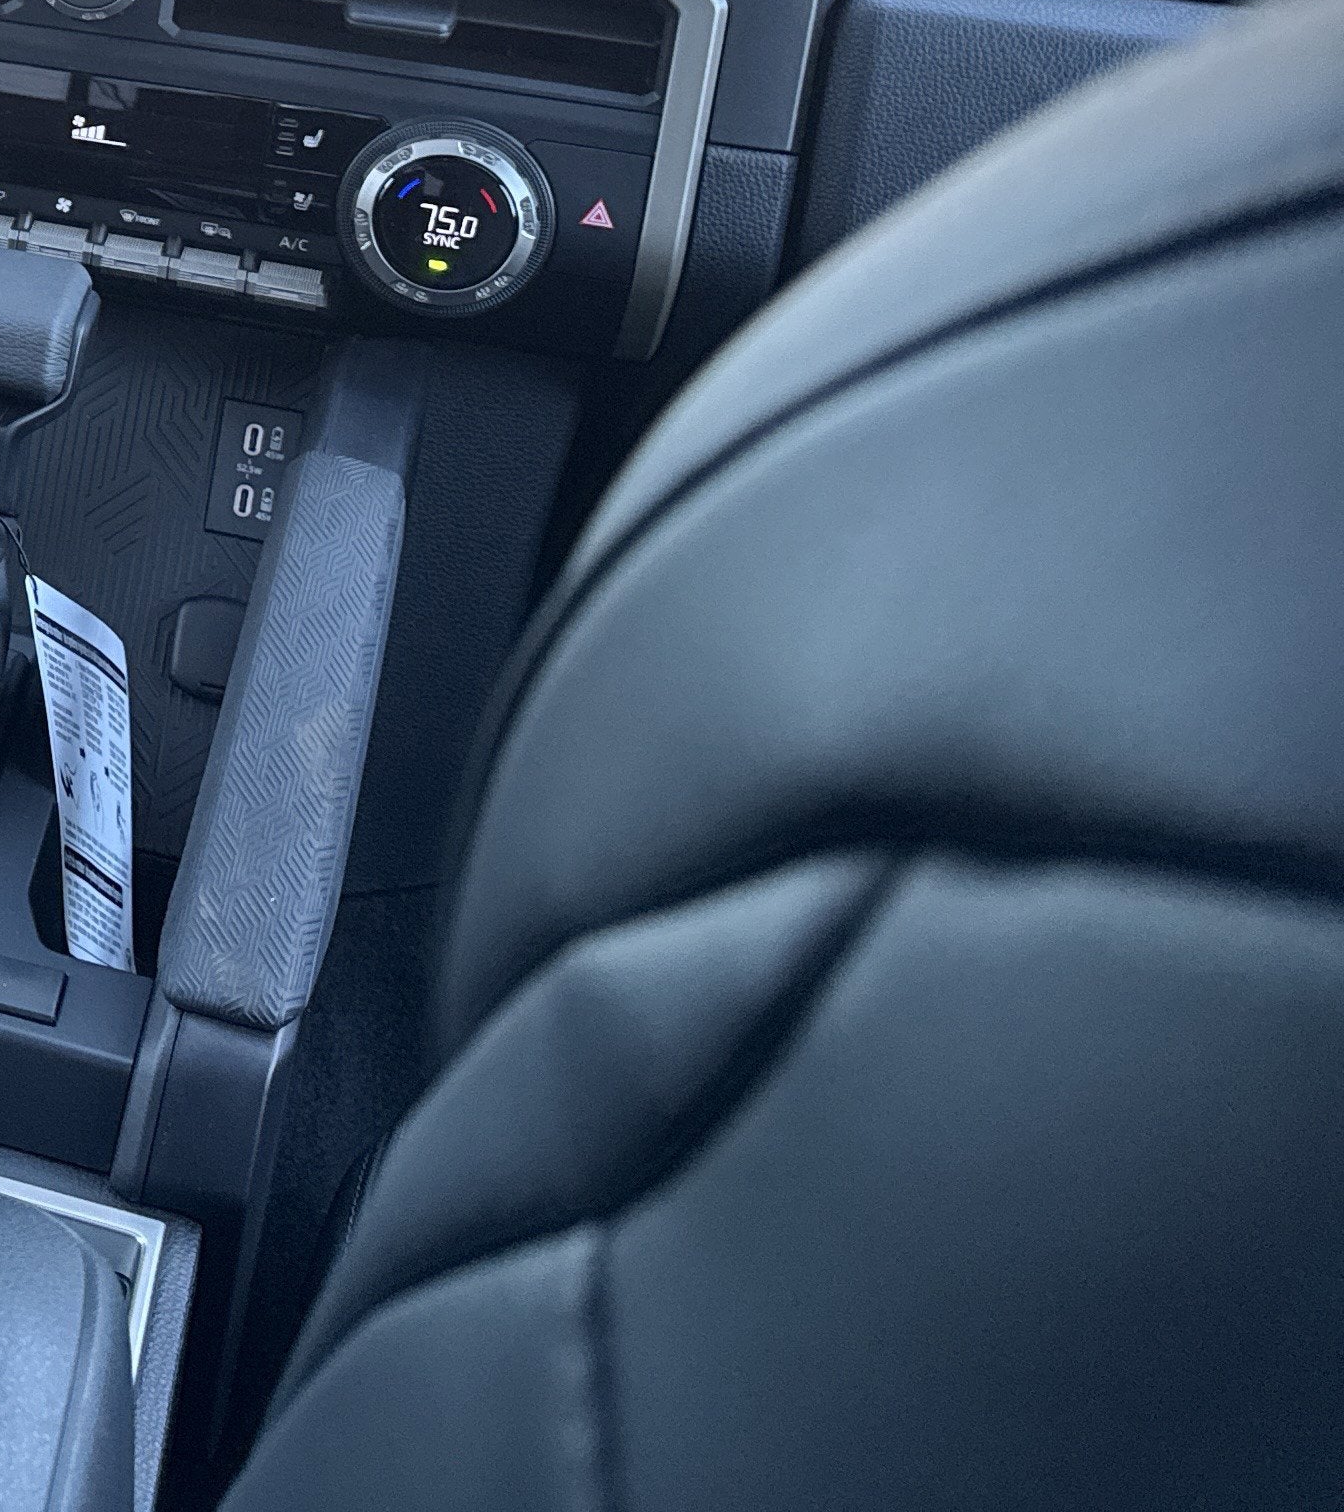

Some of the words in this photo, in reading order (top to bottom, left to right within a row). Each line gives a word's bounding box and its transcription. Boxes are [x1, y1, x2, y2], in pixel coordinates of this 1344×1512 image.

[419, 202, 479, 240] 75.0
[279, 236, 309, 252] A/C
[422, 231, 461, 251] SYNC
